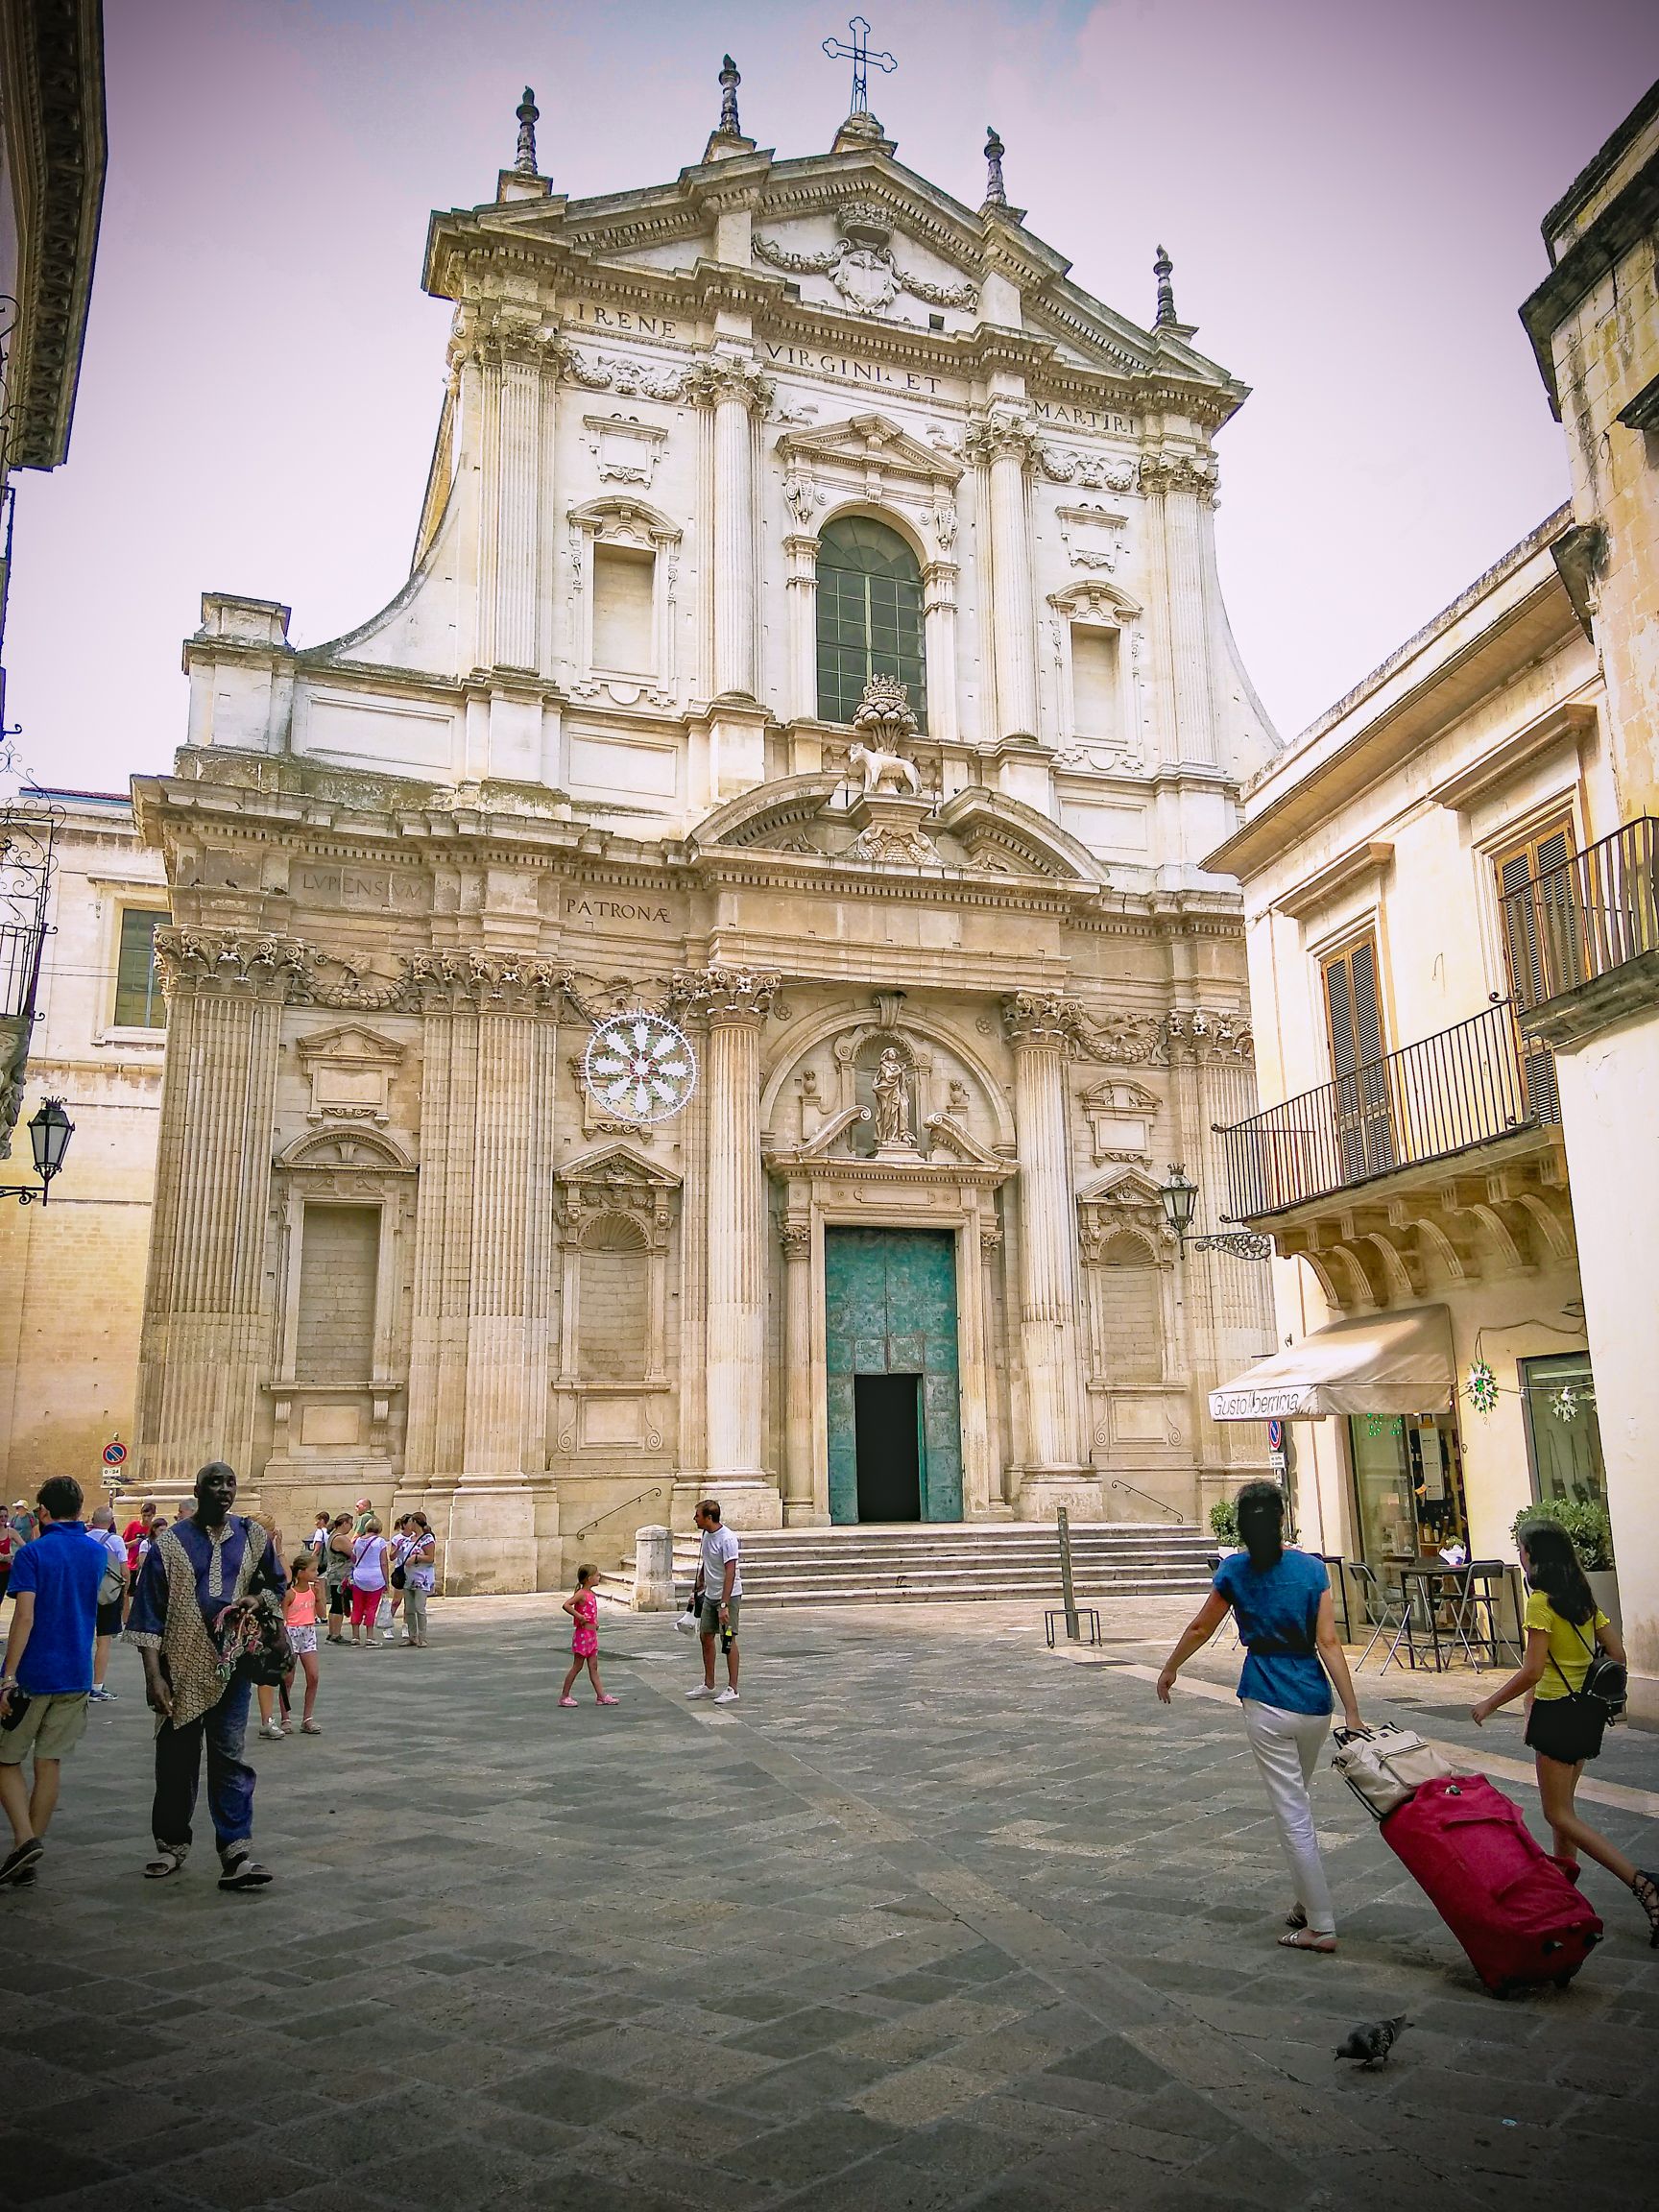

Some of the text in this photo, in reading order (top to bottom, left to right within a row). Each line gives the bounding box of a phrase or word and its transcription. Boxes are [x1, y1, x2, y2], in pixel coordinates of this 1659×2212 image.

[578, 302, 676, 339] IRENE
[903, 373, 942, 394] ET
[1034, 399, 1135, 435] MARTIRI
